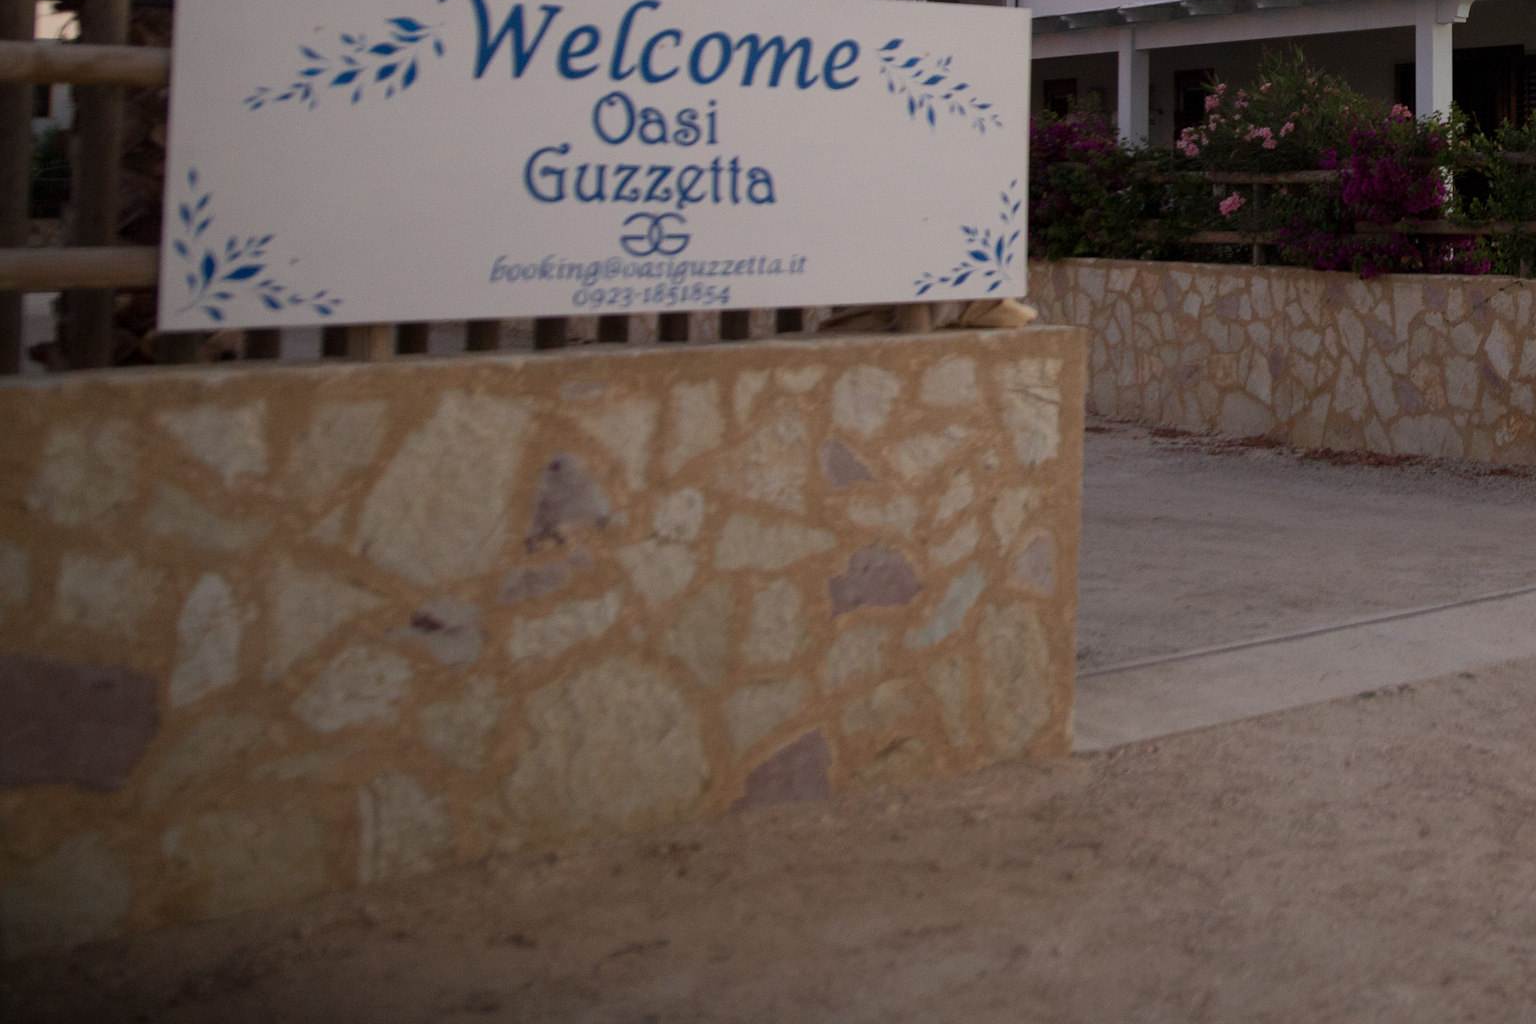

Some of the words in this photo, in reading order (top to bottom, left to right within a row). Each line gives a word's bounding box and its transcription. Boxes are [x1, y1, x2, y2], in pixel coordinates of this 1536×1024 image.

[592, 91, 718, 147] Oasi
[522, 143, 777, 211] Guzzetta
[488, 254, 808, 286] booking@oasiguzzetta.it
